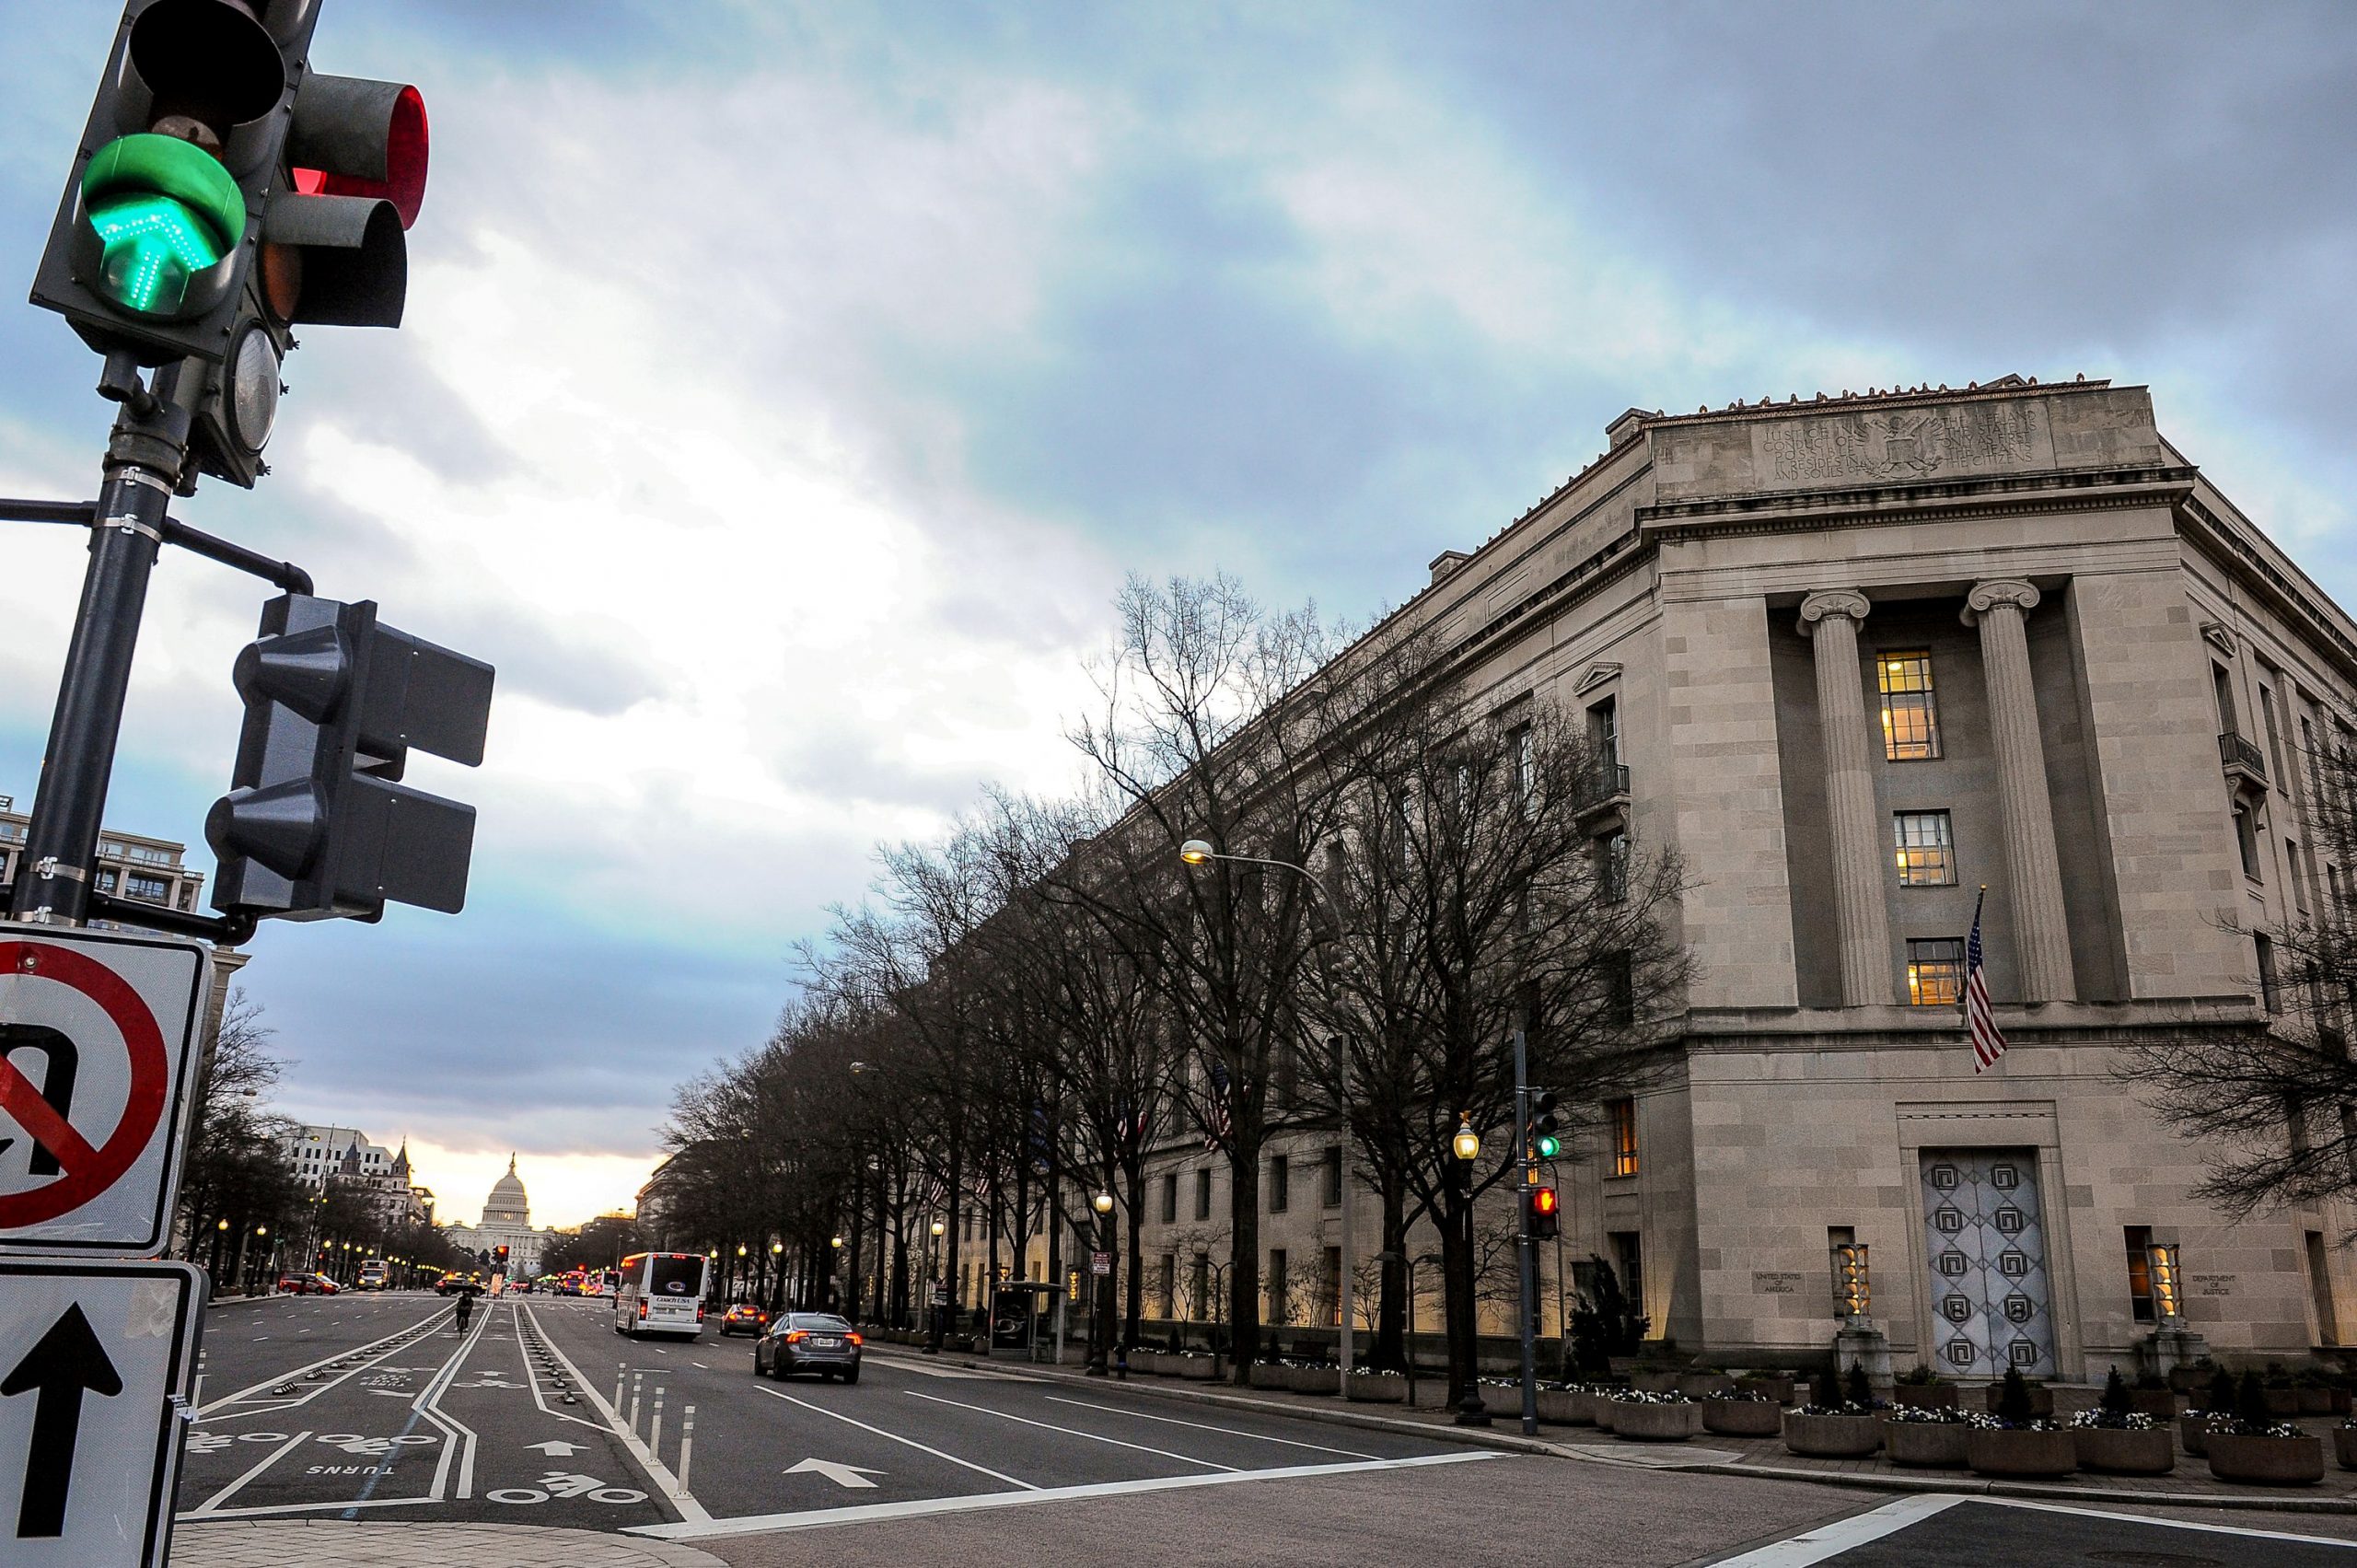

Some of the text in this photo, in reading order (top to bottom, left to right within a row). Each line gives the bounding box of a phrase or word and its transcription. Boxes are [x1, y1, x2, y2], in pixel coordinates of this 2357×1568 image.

[1763, 438, 1829, 451] CONDUCT
[1836, 436, 1853, 447] OF
[1945, 426, 1968, 437] THE
[1979, 423, 2017, 435] STATE
[1766, 411, 2037, 440] JUSTICE IN THE LIFE AND
[1775, 431, 2029, 460] POSSIBLE ONLY AS FIRST
[1775, 443, 2031, 472] IT RESIDES IN THE HEARTS
[1774, 470, 1798, 480] AND
[1805, 467, 1843, 479] SOULS
[1945, 458, 1968, 468] THE
[1972, 452, 2032, 466] CITIZENS
[306, 1466, 394, 1475] TURNS
